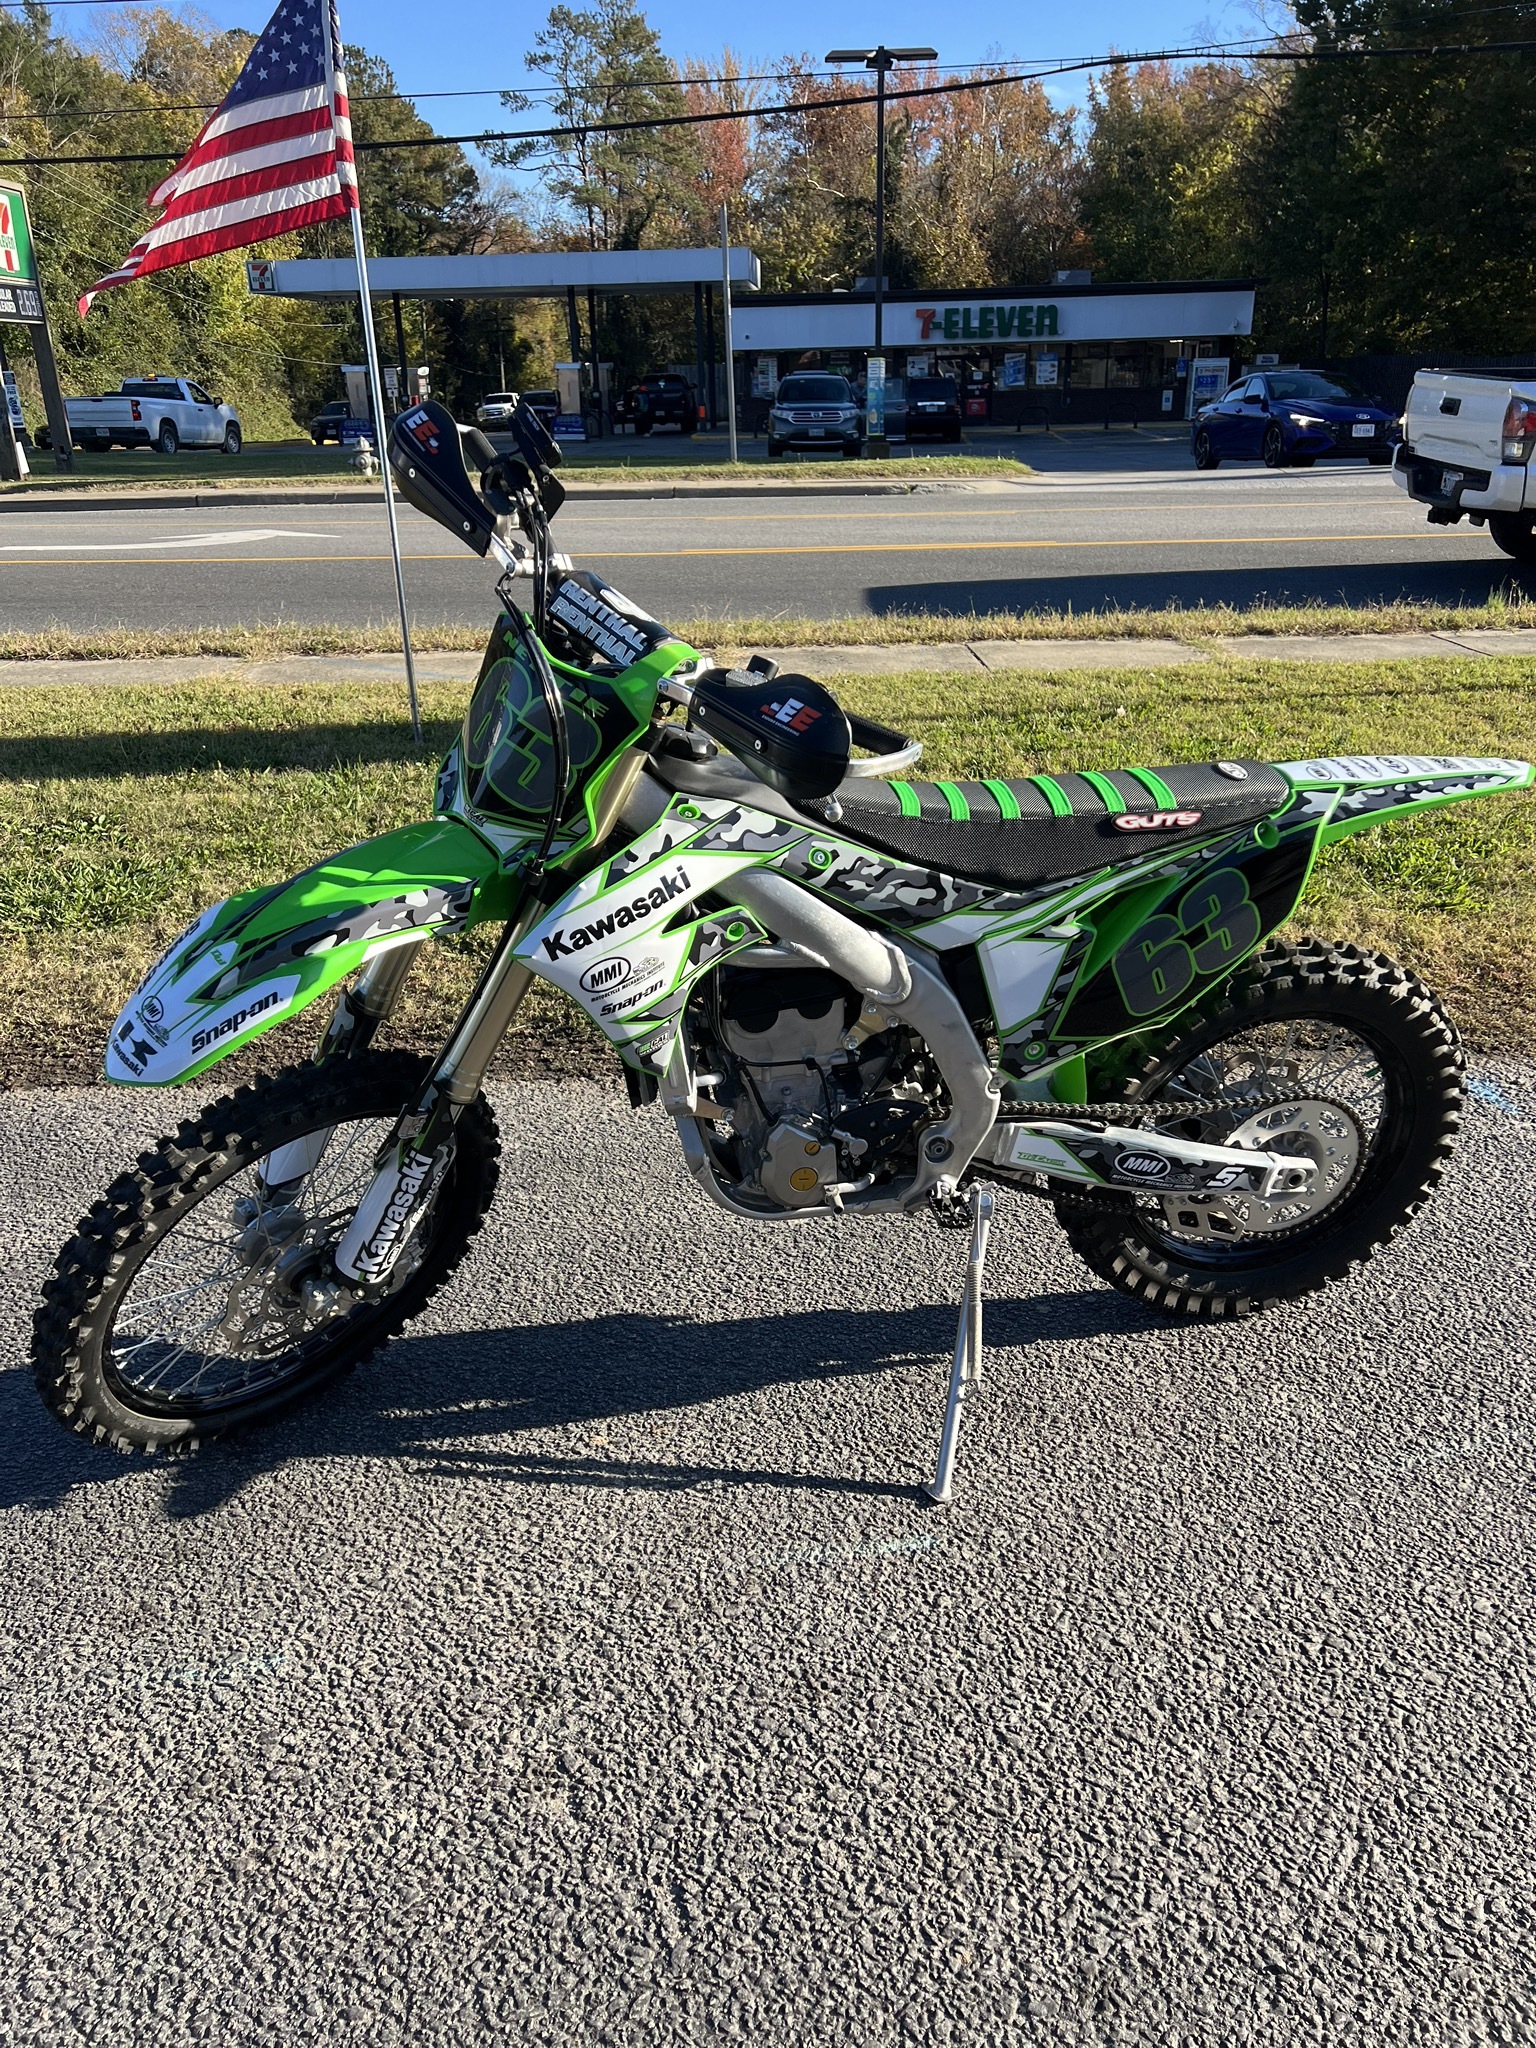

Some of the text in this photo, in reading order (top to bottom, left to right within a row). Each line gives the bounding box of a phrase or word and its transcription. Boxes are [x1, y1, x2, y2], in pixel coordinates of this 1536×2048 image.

[550, 596, 637, 667] RENTHAL
[559, 579, 647, 651] RENTHAL
[1115, 811, 1202, 830] GUTS
[541, 865, 692, 962] Kawasaki
[1111, 867, 1261, 1016] 63
[590, 960, 623, 989] MMI
[590, 985, 621, 1003] MOTORCYCLE
[599, 979, 664, 1016] Snap-on
[191, 991, 280, 1055] Snap-on
[111, 1038, 148, 1078] Kawasaki
[1111, 1174, 1146, 1184] MOTORCYCLE
[1122, 1156, 1165, 1174] MMI
[356, 1150, 434, 1273] Kawasaki
